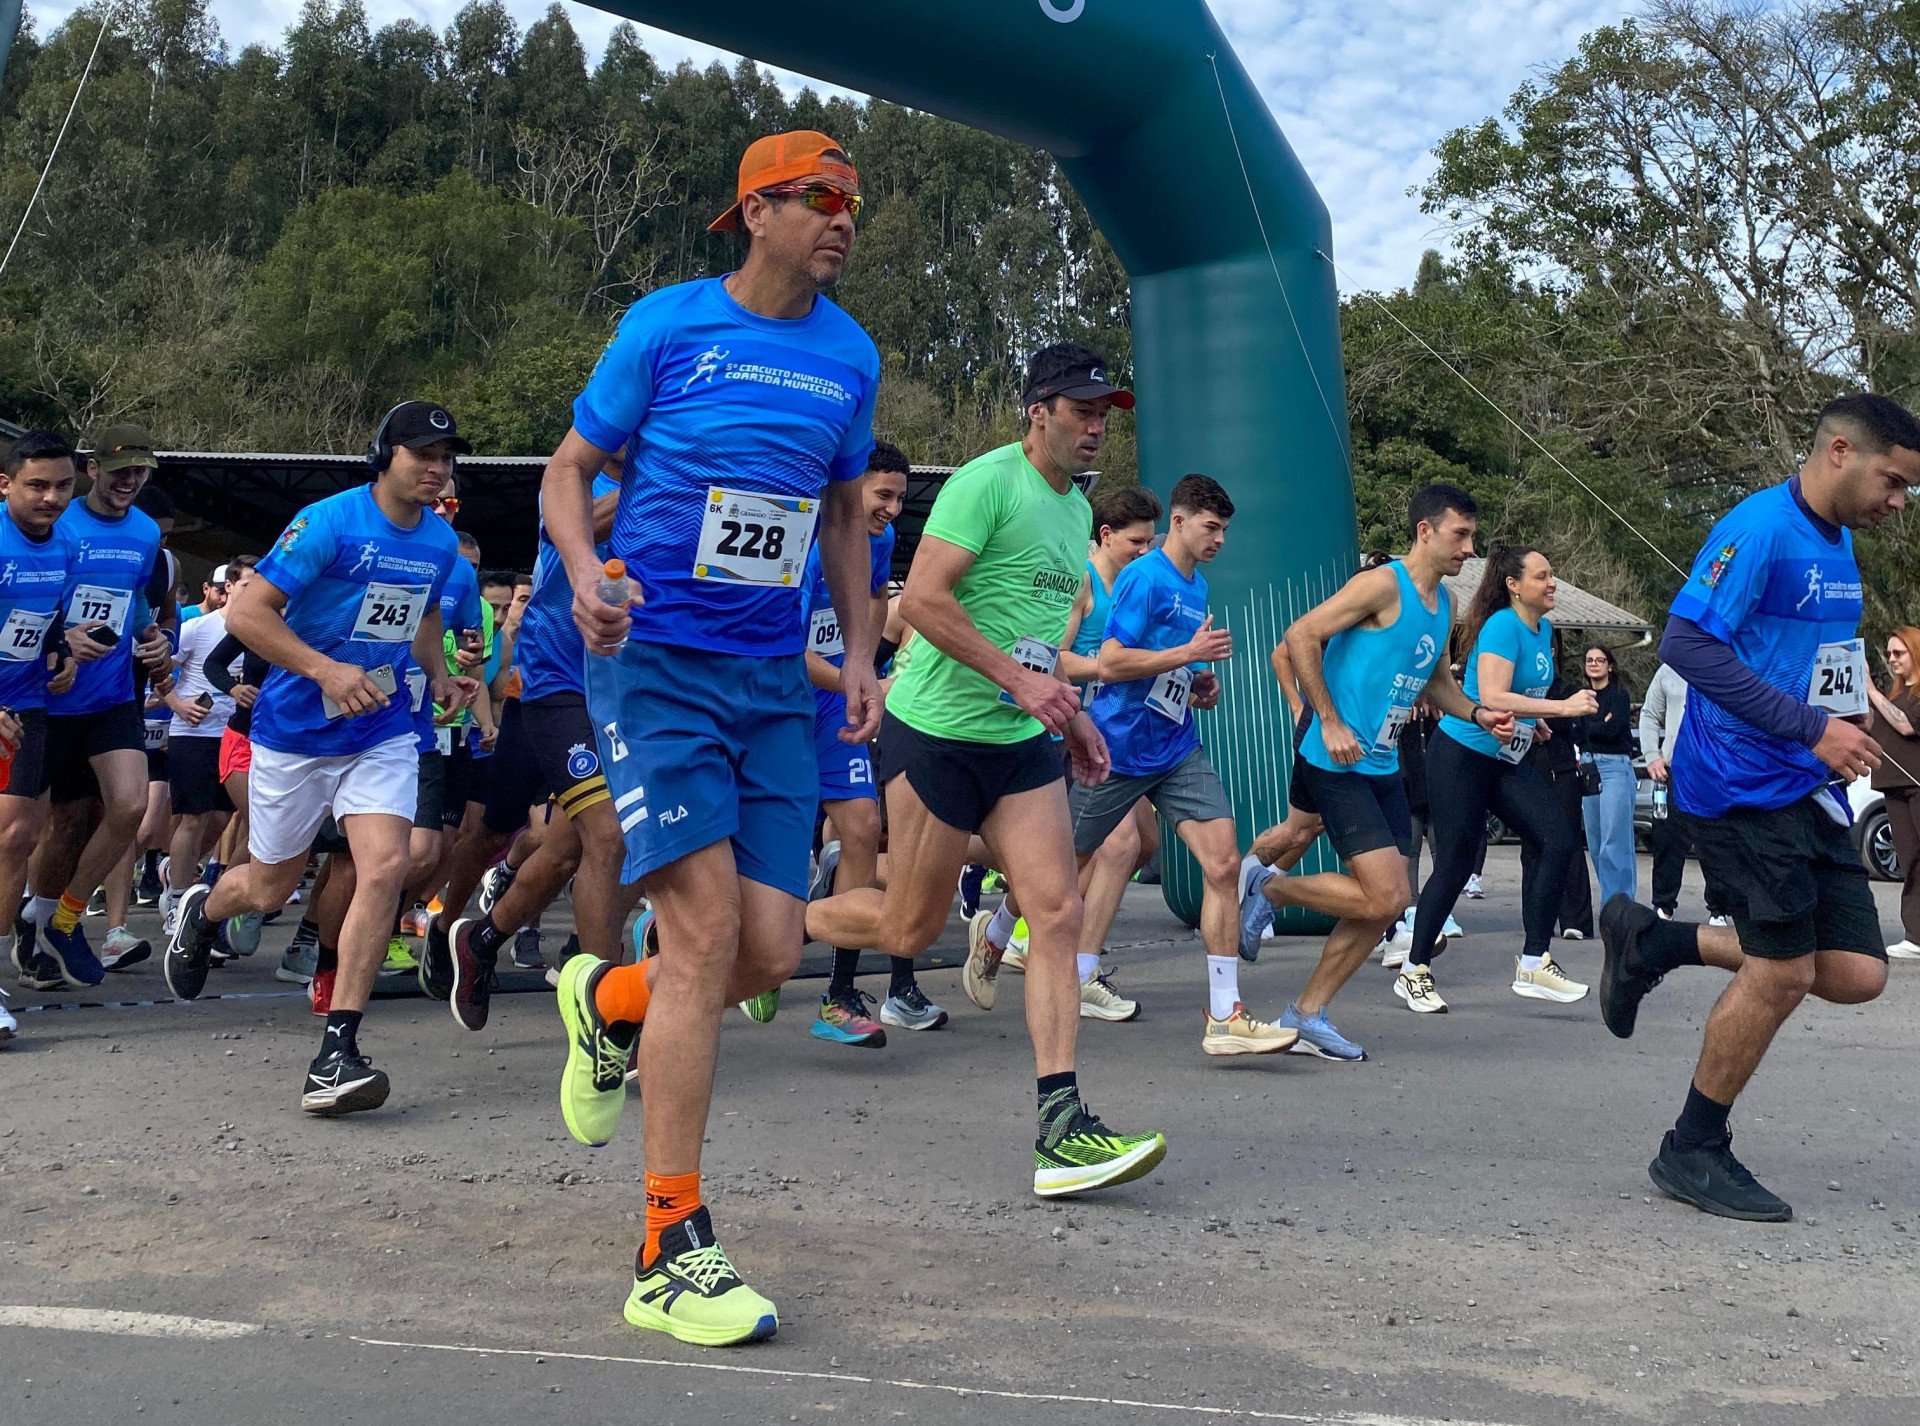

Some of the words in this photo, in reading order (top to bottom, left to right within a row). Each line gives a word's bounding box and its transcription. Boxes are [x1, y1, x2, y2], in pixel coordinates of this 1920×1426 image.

[725, 372, 781, 386] CORRIDA
[783, 380, 845, 400] MUNICIPAL
[739, 364, 791, 378] CIRCUITO
[792, 372, 844, 391] MUNICIPAL
[710, 504, 723, 514] 6K
[716, 521, 785, 560] 228
[1034, 572, 1079, 596] GRAMADO
[82, 602, 112, 621] 173
[367, 603, 411, 626] 243
[12, 629, 42, 648] 125
[1164, 680, 1186, 705] 112
[1819, 666, 1853, 696] 242
[849, 758, 873, 784] 21
[659, 805, 689, 828] FILA
